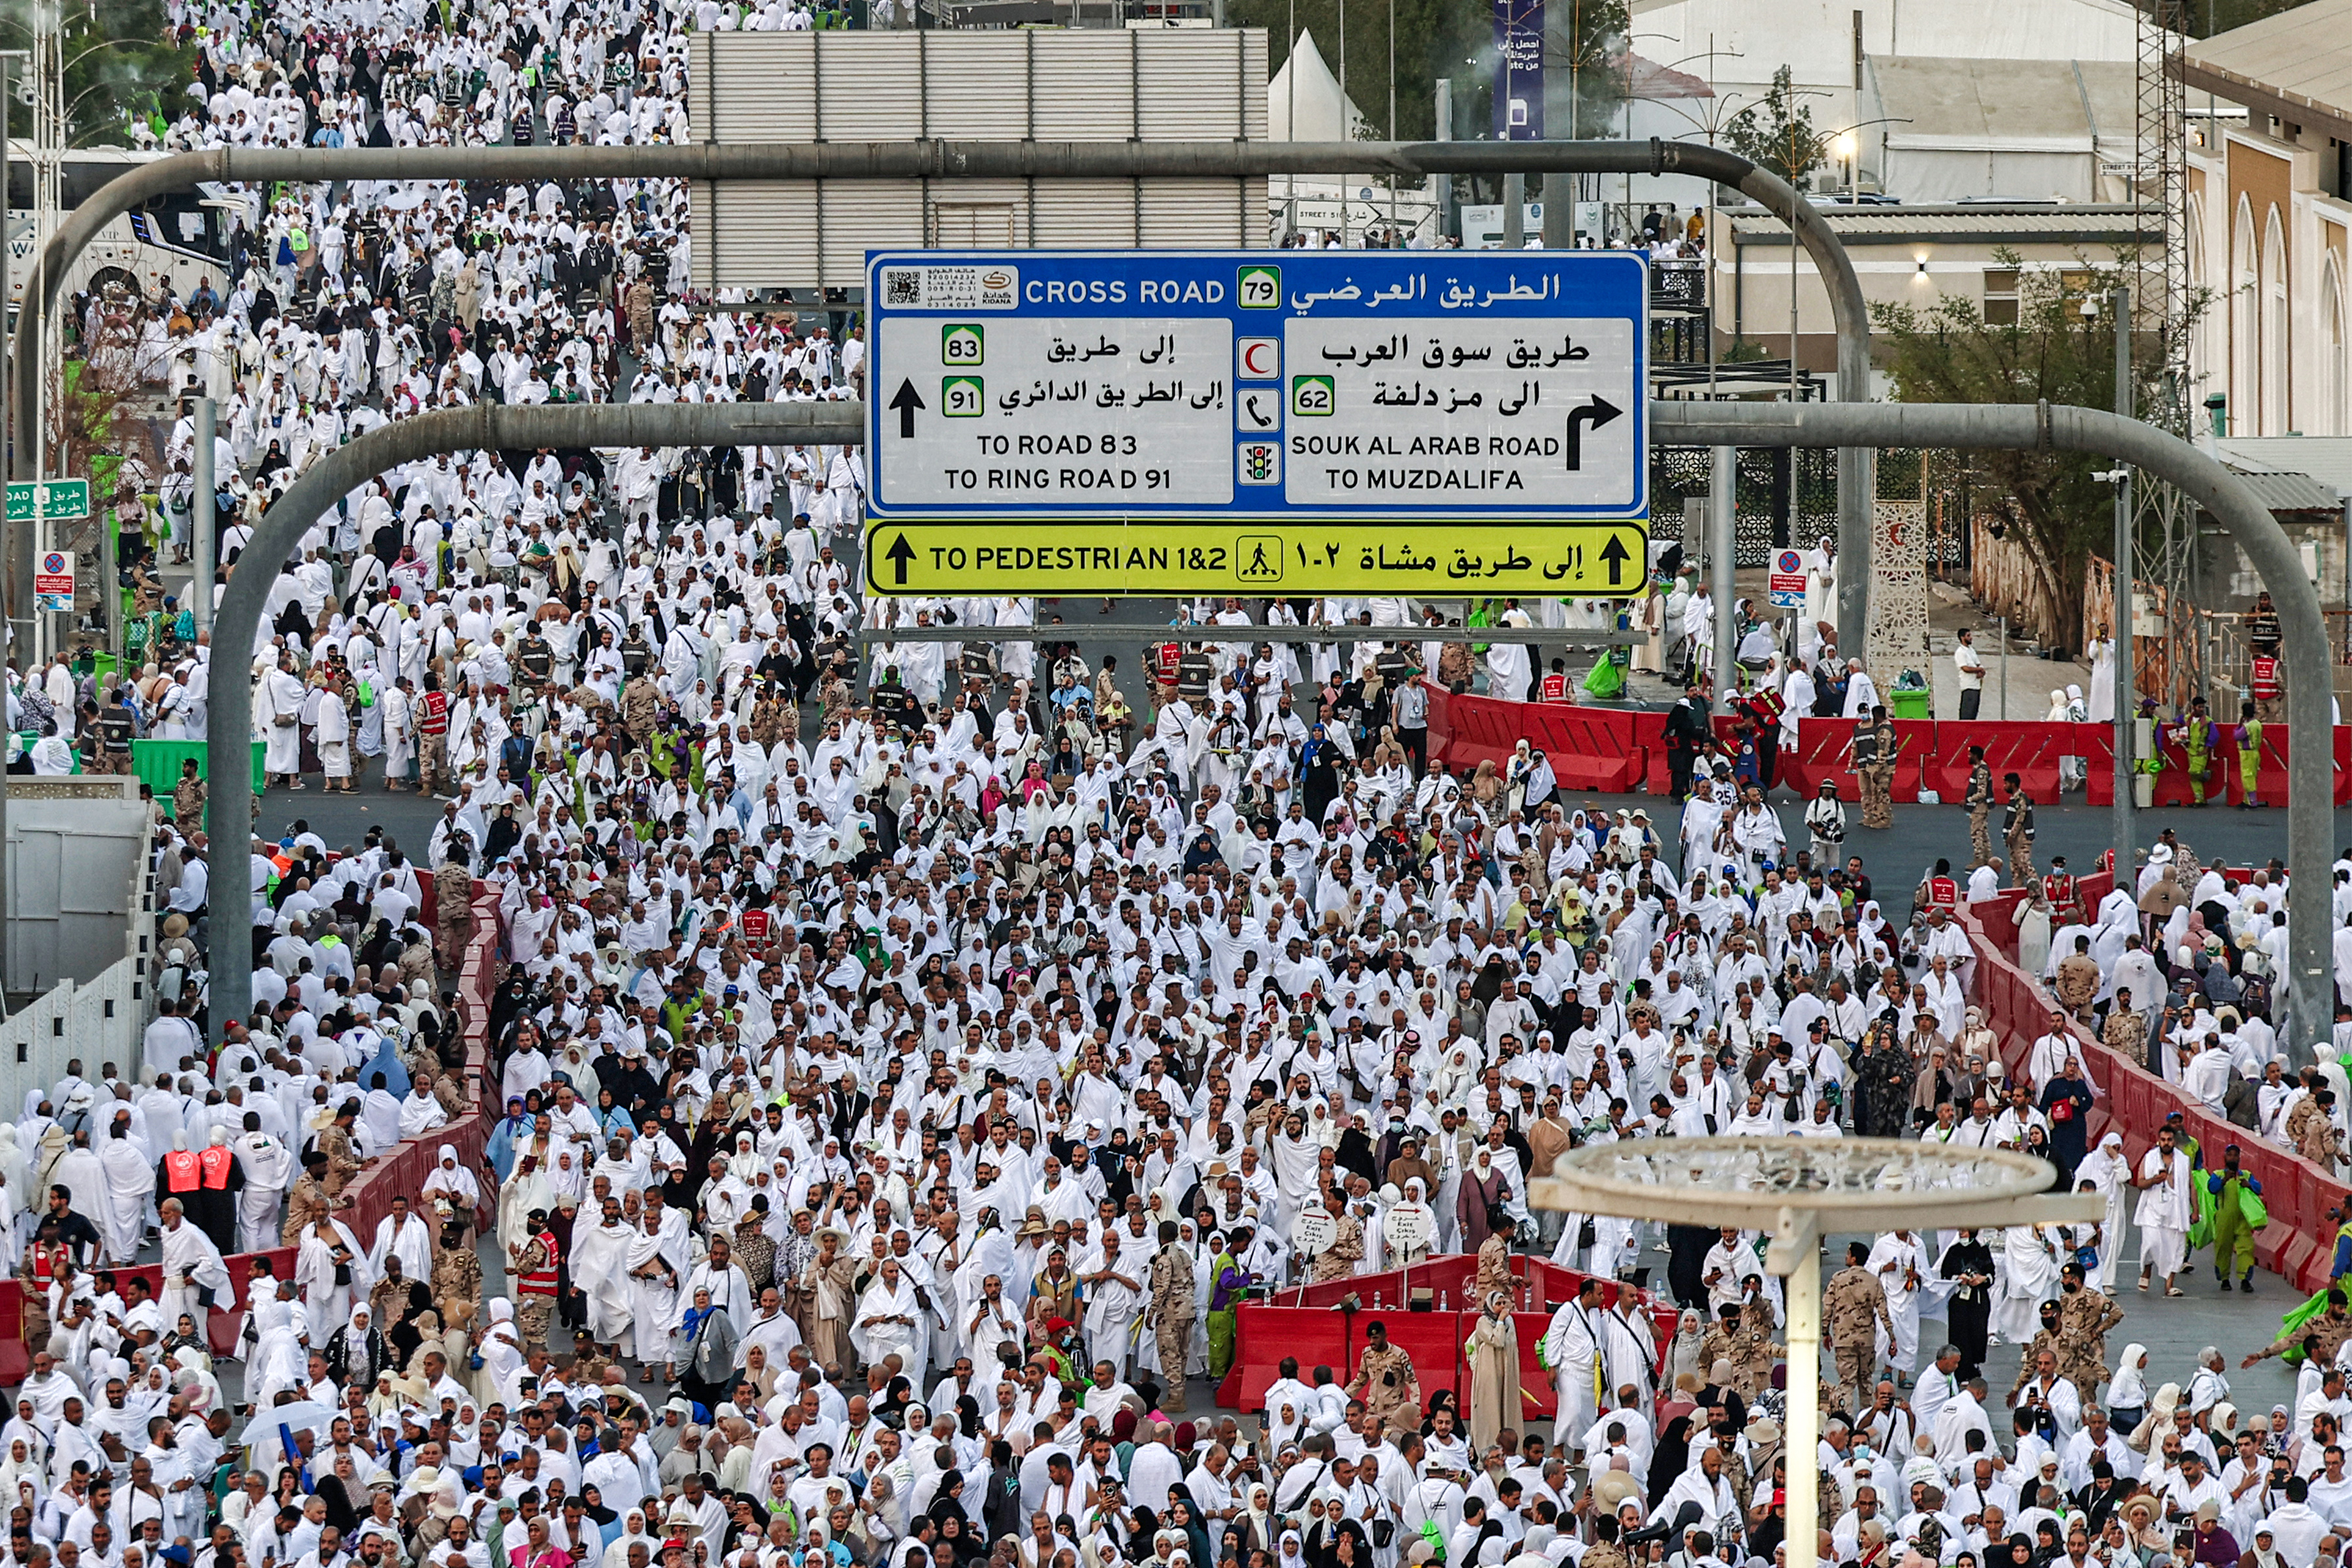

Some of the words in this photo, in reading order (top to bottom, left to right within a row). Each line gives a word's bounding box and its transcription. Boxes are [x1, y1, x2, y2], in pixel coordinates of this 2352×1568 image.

[1526, 61, 1539, 71] من
[1346, 211, 1367, 222] شارع
[1025, 280, 1128, 304] CROSS
[1139, 280, 1225, 304] ROAD
[1245, 282, 1274, 301] 79
[1291, 274, 1427, 316] العرضي
[1439, 274, 1560, 309] الطريق
[949, 339, 978, 358] 83
[1047, 335, 1121, 366] طريق
[1139, 334, 1175, 365] إلى
[1322, 335, 1408, 368] العرب
[1422, 338, 1492, 368] سوق
[1507, 335, 1590, 368] طريق
[949, 391, 975, 410] 91
[998, 380, 1086, 416] الدائري
[1096, 380, 1183, 410] الطريق
[1190, 380, 1223, 411] إلى
[1299, 391, 1328, 408] 62
[1373, 380, 1482, 414] مزدلفة
[977, 435, 1010, 455] TO
[1019, 435, 1092, 455] ROAD
[1100, 435, 1137, 455] 83
[1291, 436, 1360, 456] SOUK
[1368, 436, 1402, 455] AL
[1409, 436, 1480, 455] ARAB
[1490, 436, 1560, 456] ROAD
[945, 470, 977, 489] TO
[988, 470, 1050, 489] RING
[1060, 470, 1137, 489] ROAD
[1145, 470, 1171, 489] 91
[1326, 470, 1358, 489] TO
[1367, 470, 1524, 489] MUZDALIFA
[7, 491, 30, 502] OAD
[54, 489, 80, 501] طريق
[929, 547, 966, 570] TO
[977, 547, 1168, 570] PEDESTRIAN
[1178, 547, 1226, 570] 1&2
[1360, 544, 1436, 571] مشاة
[1447, 544, 1532, 578] طريق
[1543, 543, 1584, 581] إلى
[1716, 791, 1731, 806] 25
